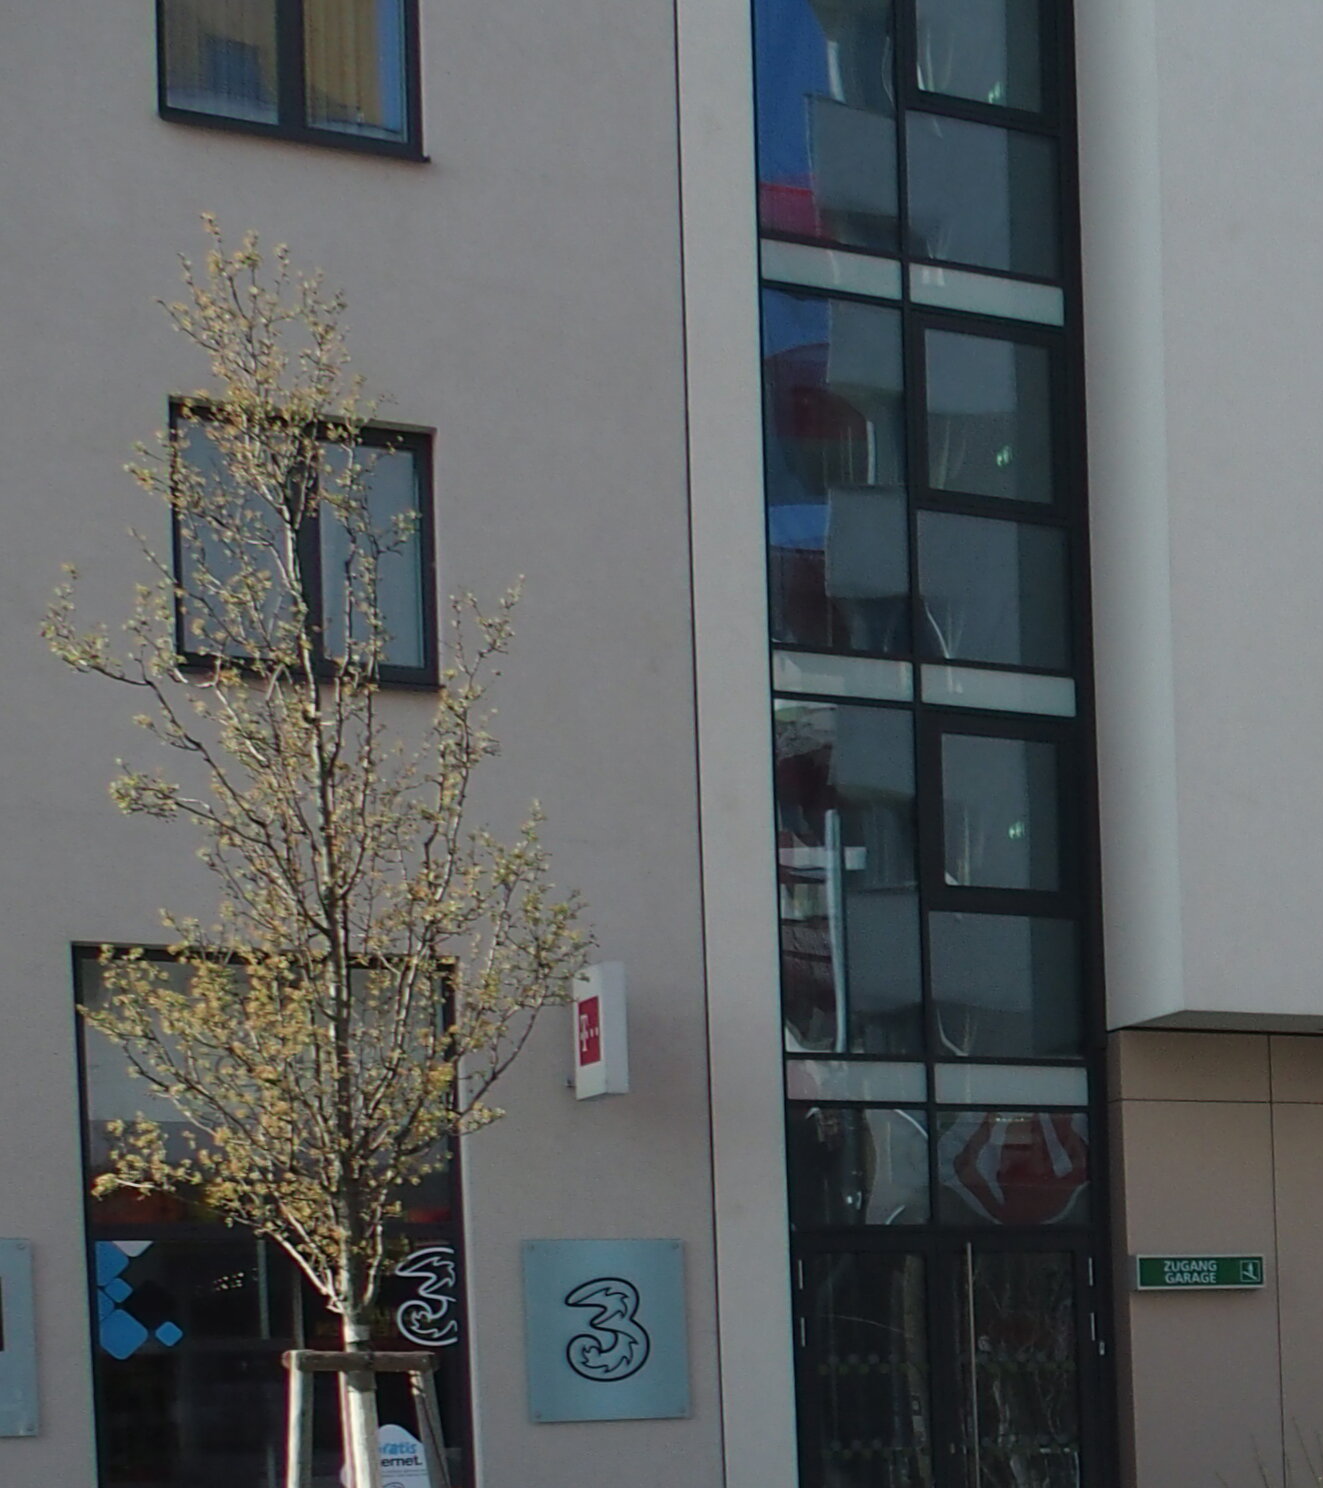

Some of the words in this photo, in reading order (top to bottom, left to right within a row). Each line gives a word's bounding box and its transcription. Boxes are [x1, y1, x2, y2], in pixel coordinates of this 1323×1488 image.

[1163, 1260, 1217, 1272] ZUGANG
[1165, 1272, 1217, 1284] GARAGE
[565, 1277, 650, 1382] 3
